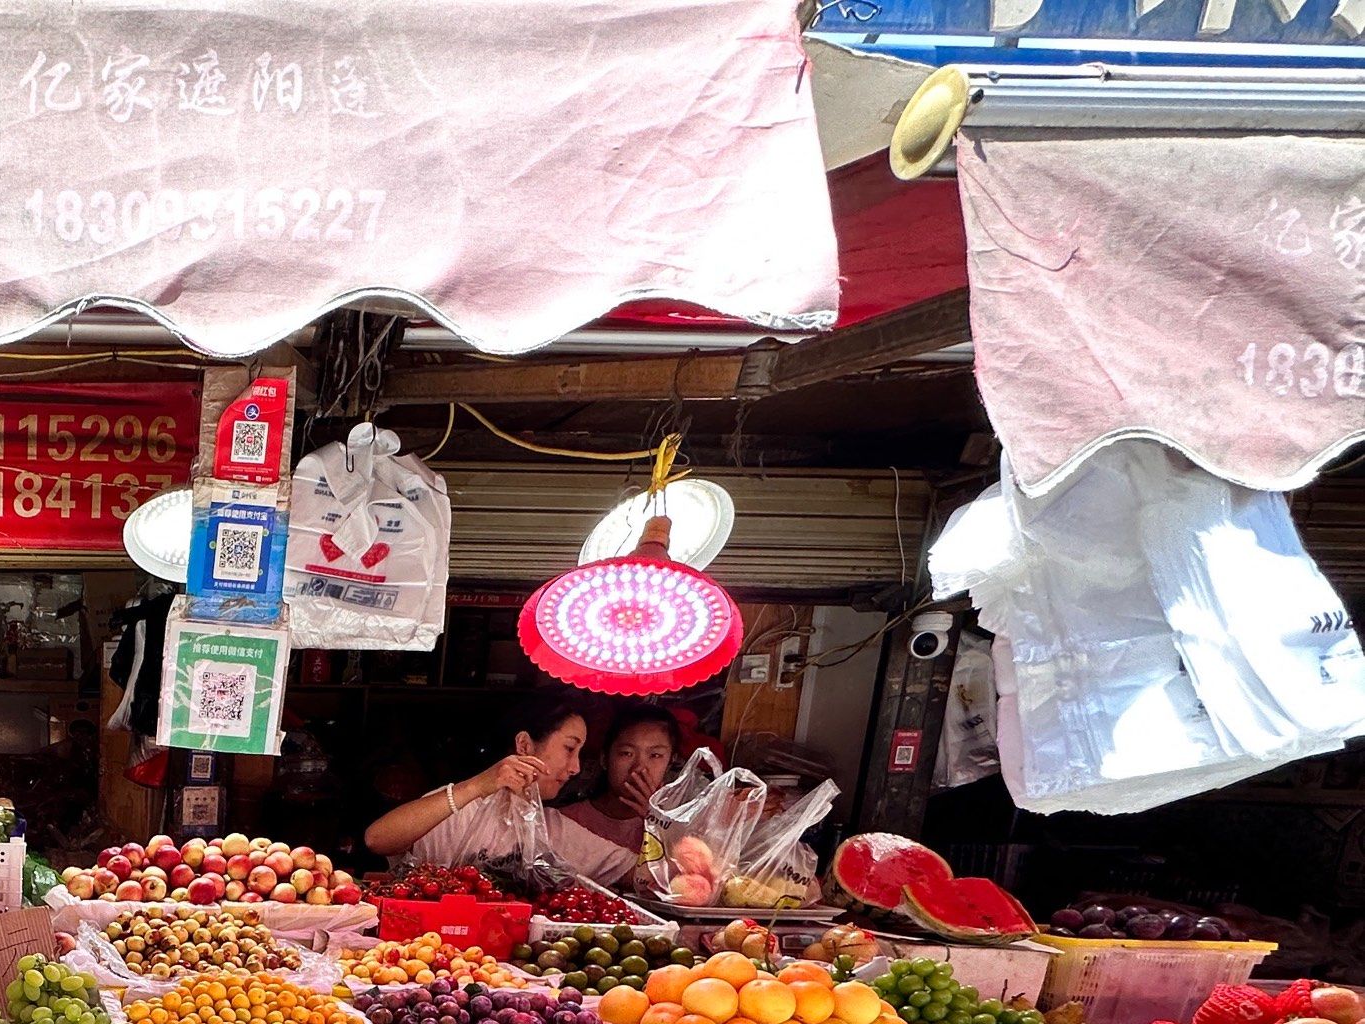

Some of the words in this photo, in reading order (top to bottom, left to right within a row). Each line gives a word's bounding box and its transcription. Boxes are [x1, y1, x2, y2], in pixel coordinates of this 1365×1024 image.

[192, 642, 263, 659] 推荐使用微信支付
